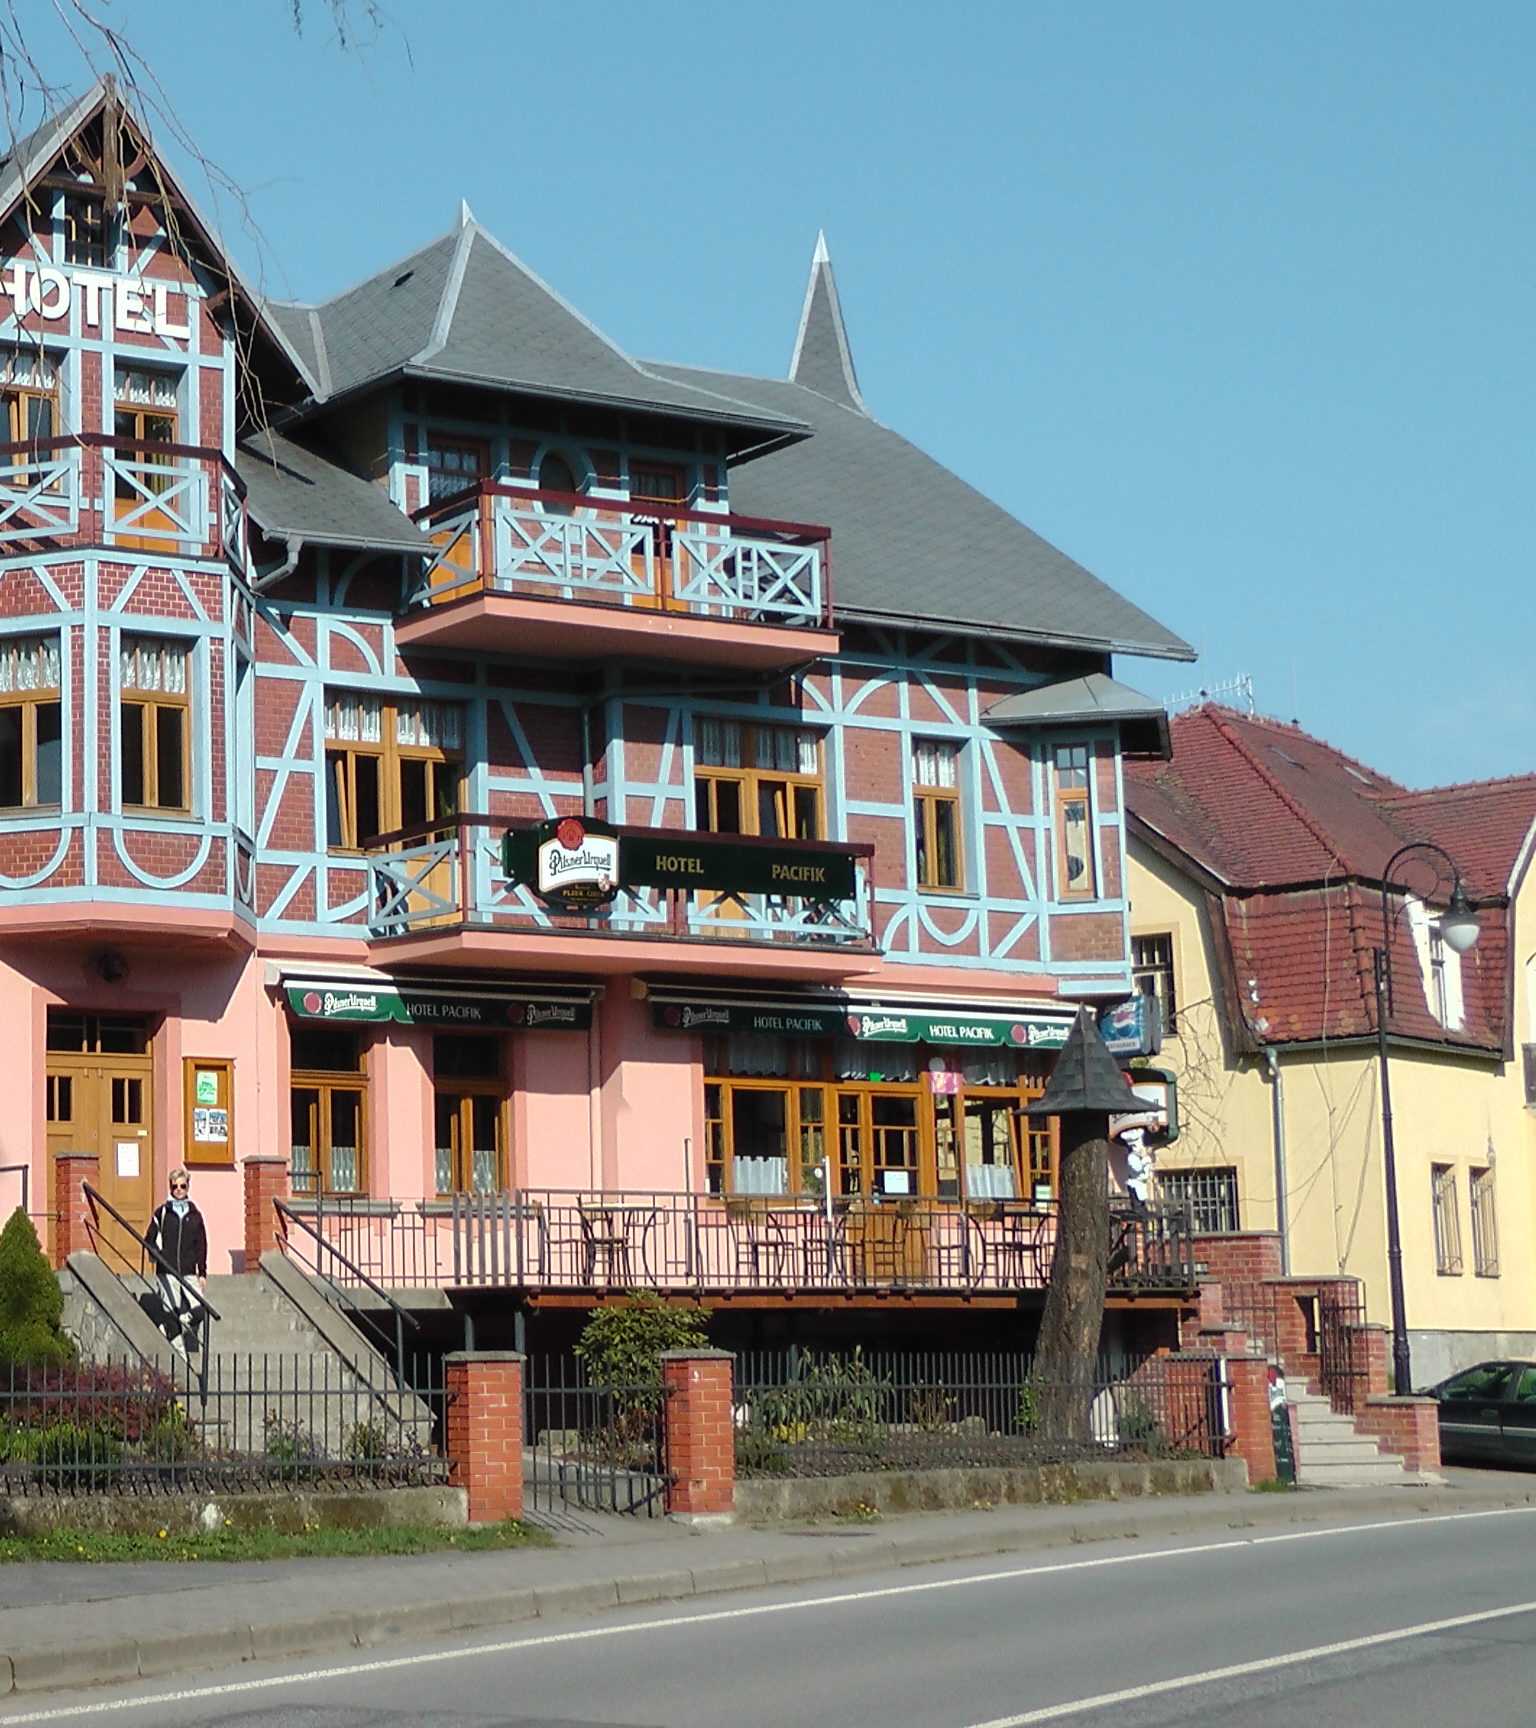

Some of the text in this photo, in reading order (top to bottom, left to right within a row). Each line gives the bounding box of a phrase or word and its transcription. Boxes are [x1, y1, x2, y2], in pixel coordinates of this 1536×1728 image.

[549, 849, 611, 876] Pilsner Urquell
[656, 855, 825, 882] HOTEL PACIFIK
[324, 992, 377, 1016] Pilsner Urquell
[406, 1003, 481, 1019] HOTEL PACIFIK
[753, 1016, 823, 1031] HOTEL PACIFIK
[862, 1016, 908, 1037] Pilsner Urquell
[929, 1025, 995, 1040] HOTEL PACIFIK
